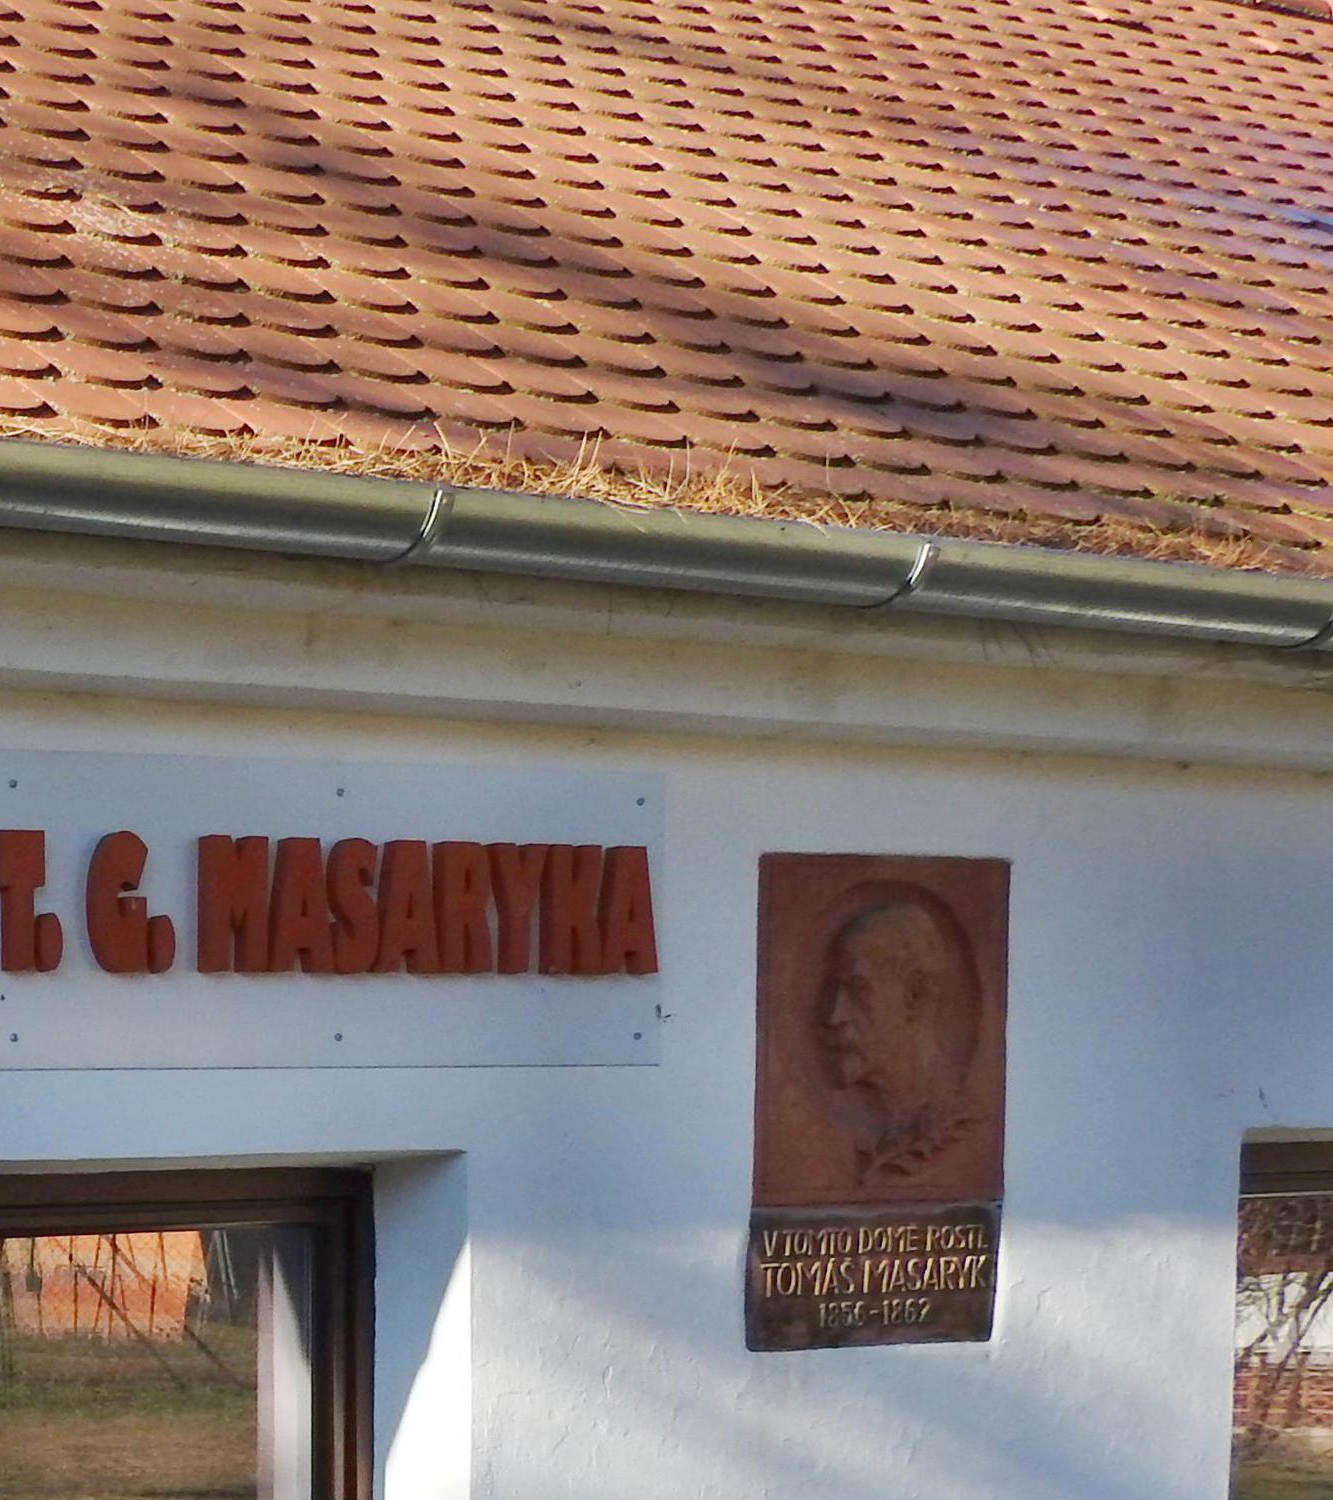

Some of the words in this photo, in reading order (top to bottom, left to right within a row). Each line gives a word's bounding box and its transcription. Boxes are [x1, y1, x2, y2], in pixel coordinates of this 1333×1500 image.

[86, 830, 177, 974] G.
[197, 834, 660, 975] MASARYKA
[763, 1230, 778, 1257] V
[783, 1228, 853, 1255] TOMTO
[925, 1223, 989, 1252] ROSTL
[760, 1257, 856, 1298] TOMÁŠ
[862, 1255, 989, 1294] MASARYK
